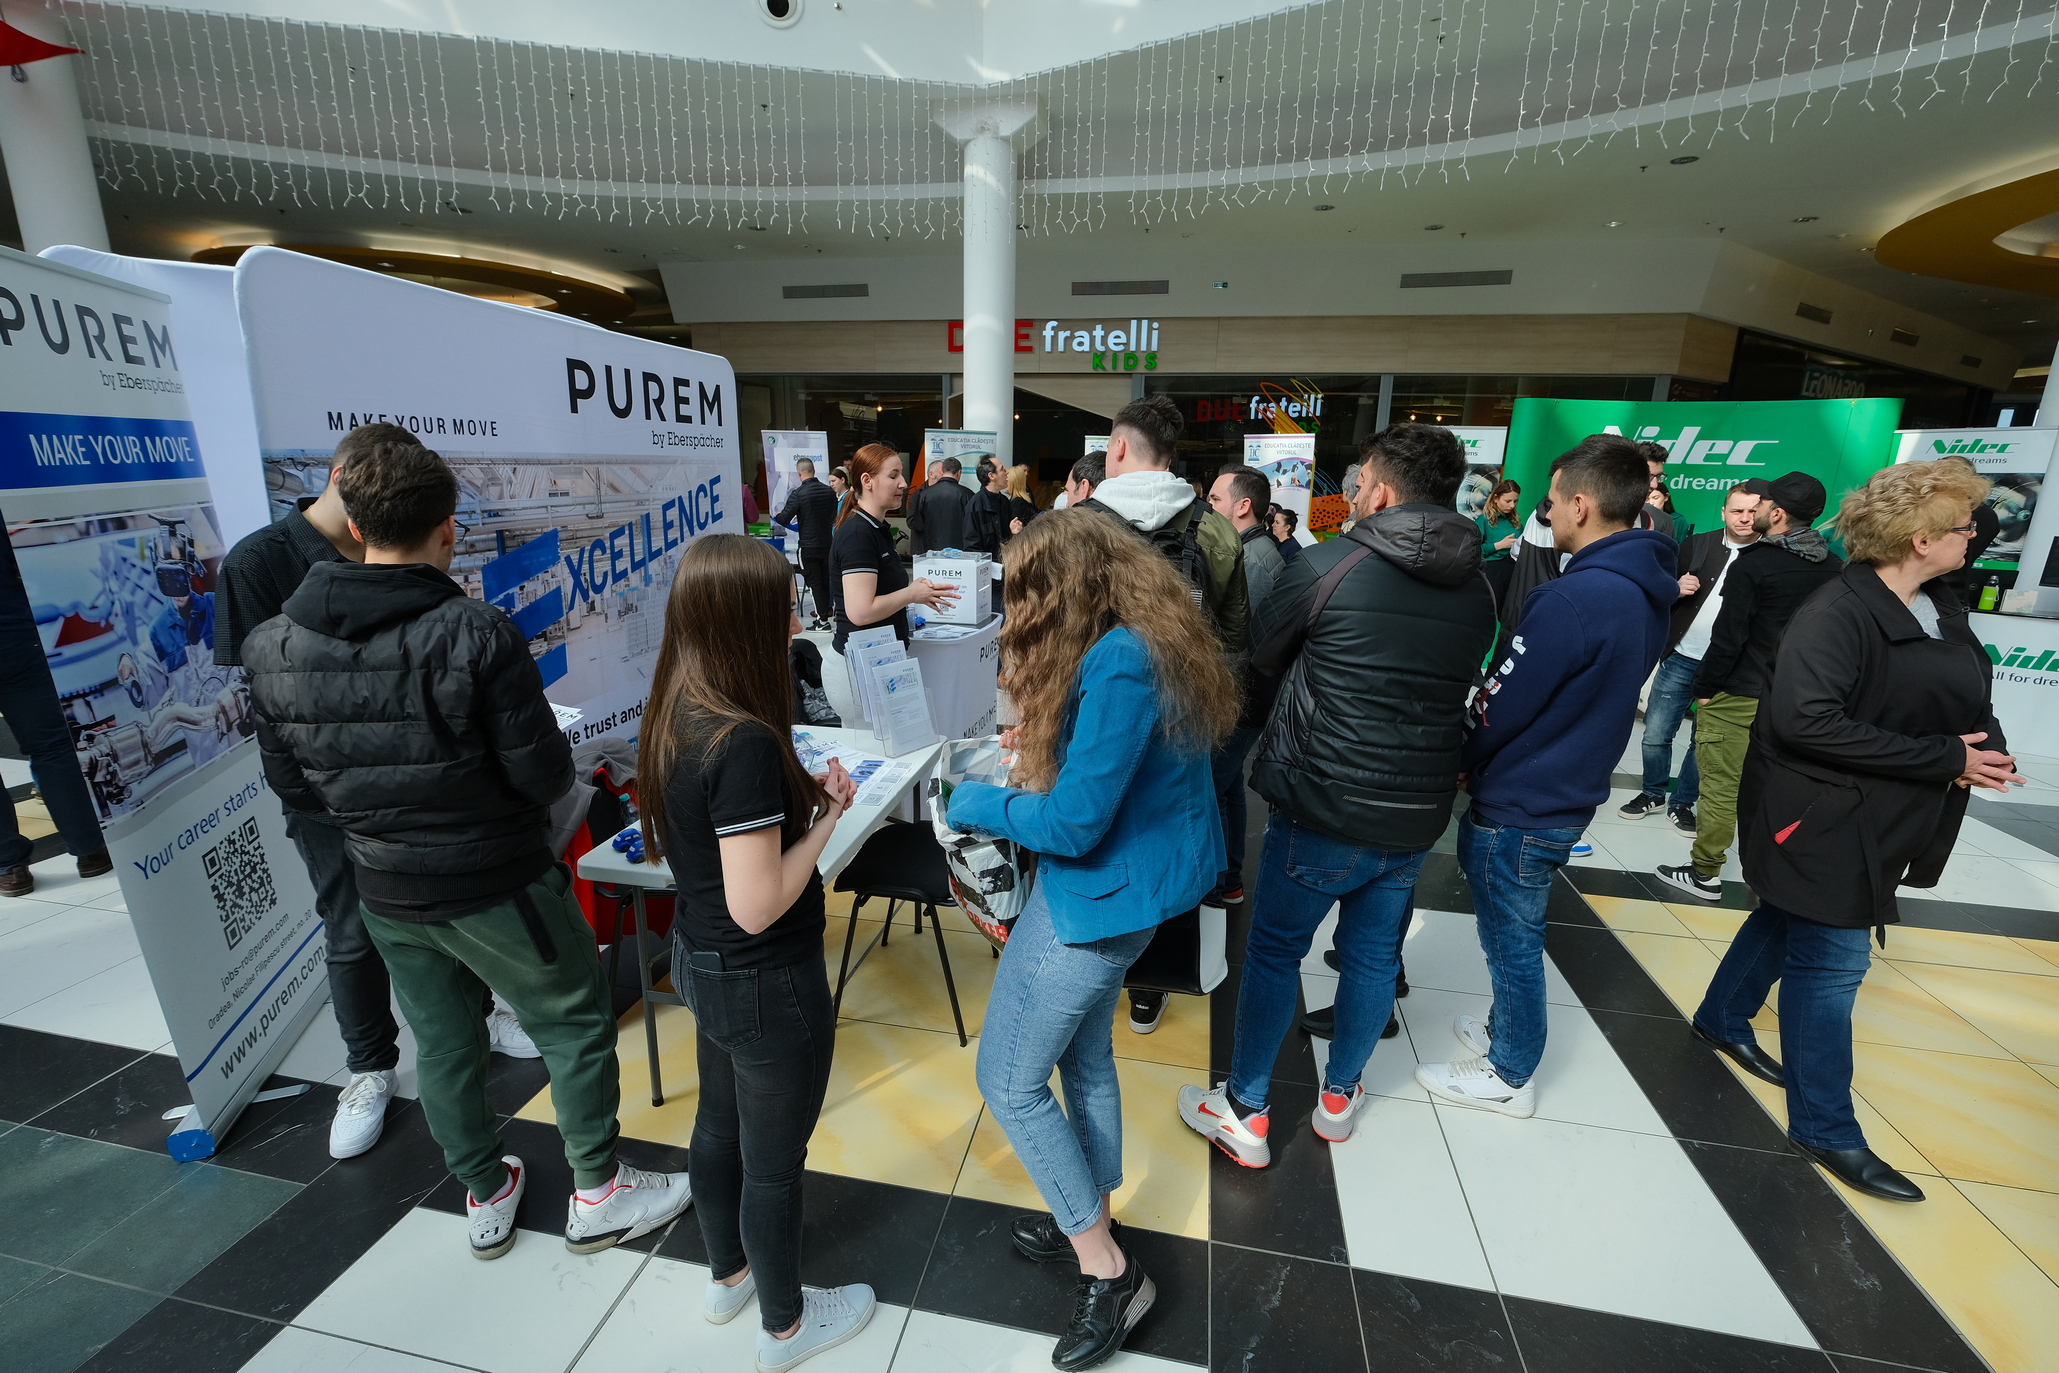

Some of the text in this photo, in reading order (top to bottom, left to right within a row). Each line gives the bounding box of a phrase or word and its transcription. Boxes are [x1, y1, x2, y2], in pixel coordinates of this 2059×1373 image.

[0, 286, 179, 371] PUREM
[948, 319, 1159, 352] DE fratelli
[1092, 352, 1158, 370] KIDS
[100, 370, 185, 394] by Eberspächer
[566, 357, 723, 427] PUREM
[1196, 398, 1245, 422] DUE
[395, 415, 447, 435] YOUR
[452, 418, 498, 437] MOVE
[652, 431, 724, 450] by Eberspächer
[29, 434, 195, 466] MAKE YOUR MOVE
[1601, 425, 1779, 466] dec
[1926, 438, 2020, 454] Nidec
[1670, 474, 1749, 490] dream
[927, 569, 962, 577] PUREM
[979, 637, 998, 663] PURE
[1983, 643, 2059, 672] Nid
[2009, 672, 2031, 684] for
[2033, 676, 2059, 687] dre
[583, 711, 618, 740] trust
[620, 699, 642, 724] and
[133, 782, 258, 880] Your career starts
[220, 912, 290, 992] jobs-ro@purem.com
[208, 1002, 233, 1030] Oradea,
[231, 974, 256, 999] Nicolae
[254, 948, 282, 978] Filipescu
[220, 945, 325, 1080] www.purem.com
